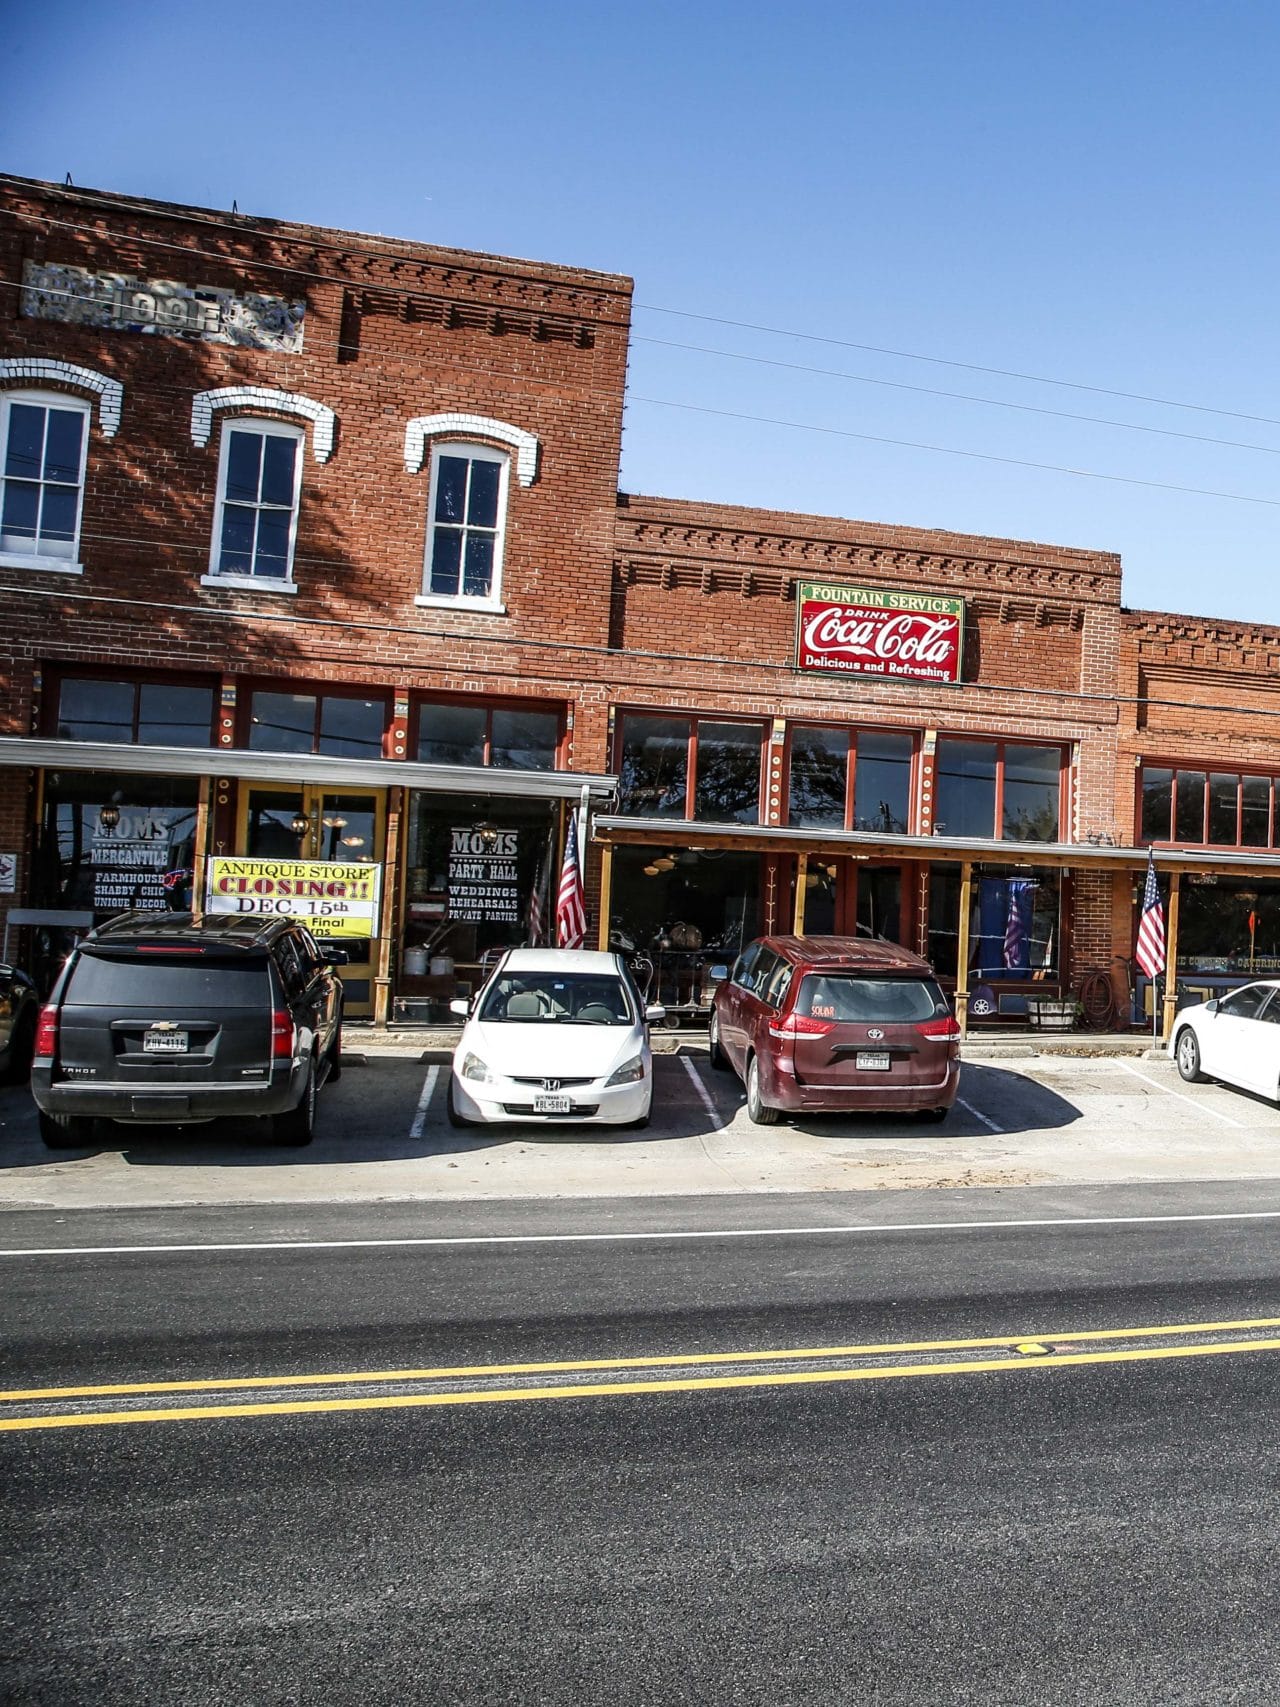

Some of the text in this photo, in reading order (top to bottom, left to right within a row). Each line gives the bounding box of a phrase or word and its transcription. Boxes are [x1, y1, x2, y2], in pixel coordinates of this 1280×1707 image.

[811, 586, 951, 613] FOUNTAIN SERVICE
[844, 609, 890, 620] DRINK
[804, 607, 958, 663] Coca-Cola
[805, 654, 950, 682] Delicious and Refreshing
[91, 848, 168, 866] MERCANTILE
[218, 862, 370, 880] ANTIQUE STORE
[449, 863, 518, 880] PARTY HALL
[95, 872, 164, 884] FARMHOUSE
[95, 885, 165, 896] SHABBY CHIC
[218, 876, 369, 899] CLOSING!!
[449, 886, 518, 897] WEDDINGS
[94, 897, 167, 909] UNIQUE DECOR
[236, 897, 349, 916] DEC. 15th
[449, 897, 518, 909] REHEARSALS
[449, 910, 518, 922] PRIVATE PARTIES
[312, 917, 345, 928] Final
[62, 1066, 97, 1074] TAHOE
